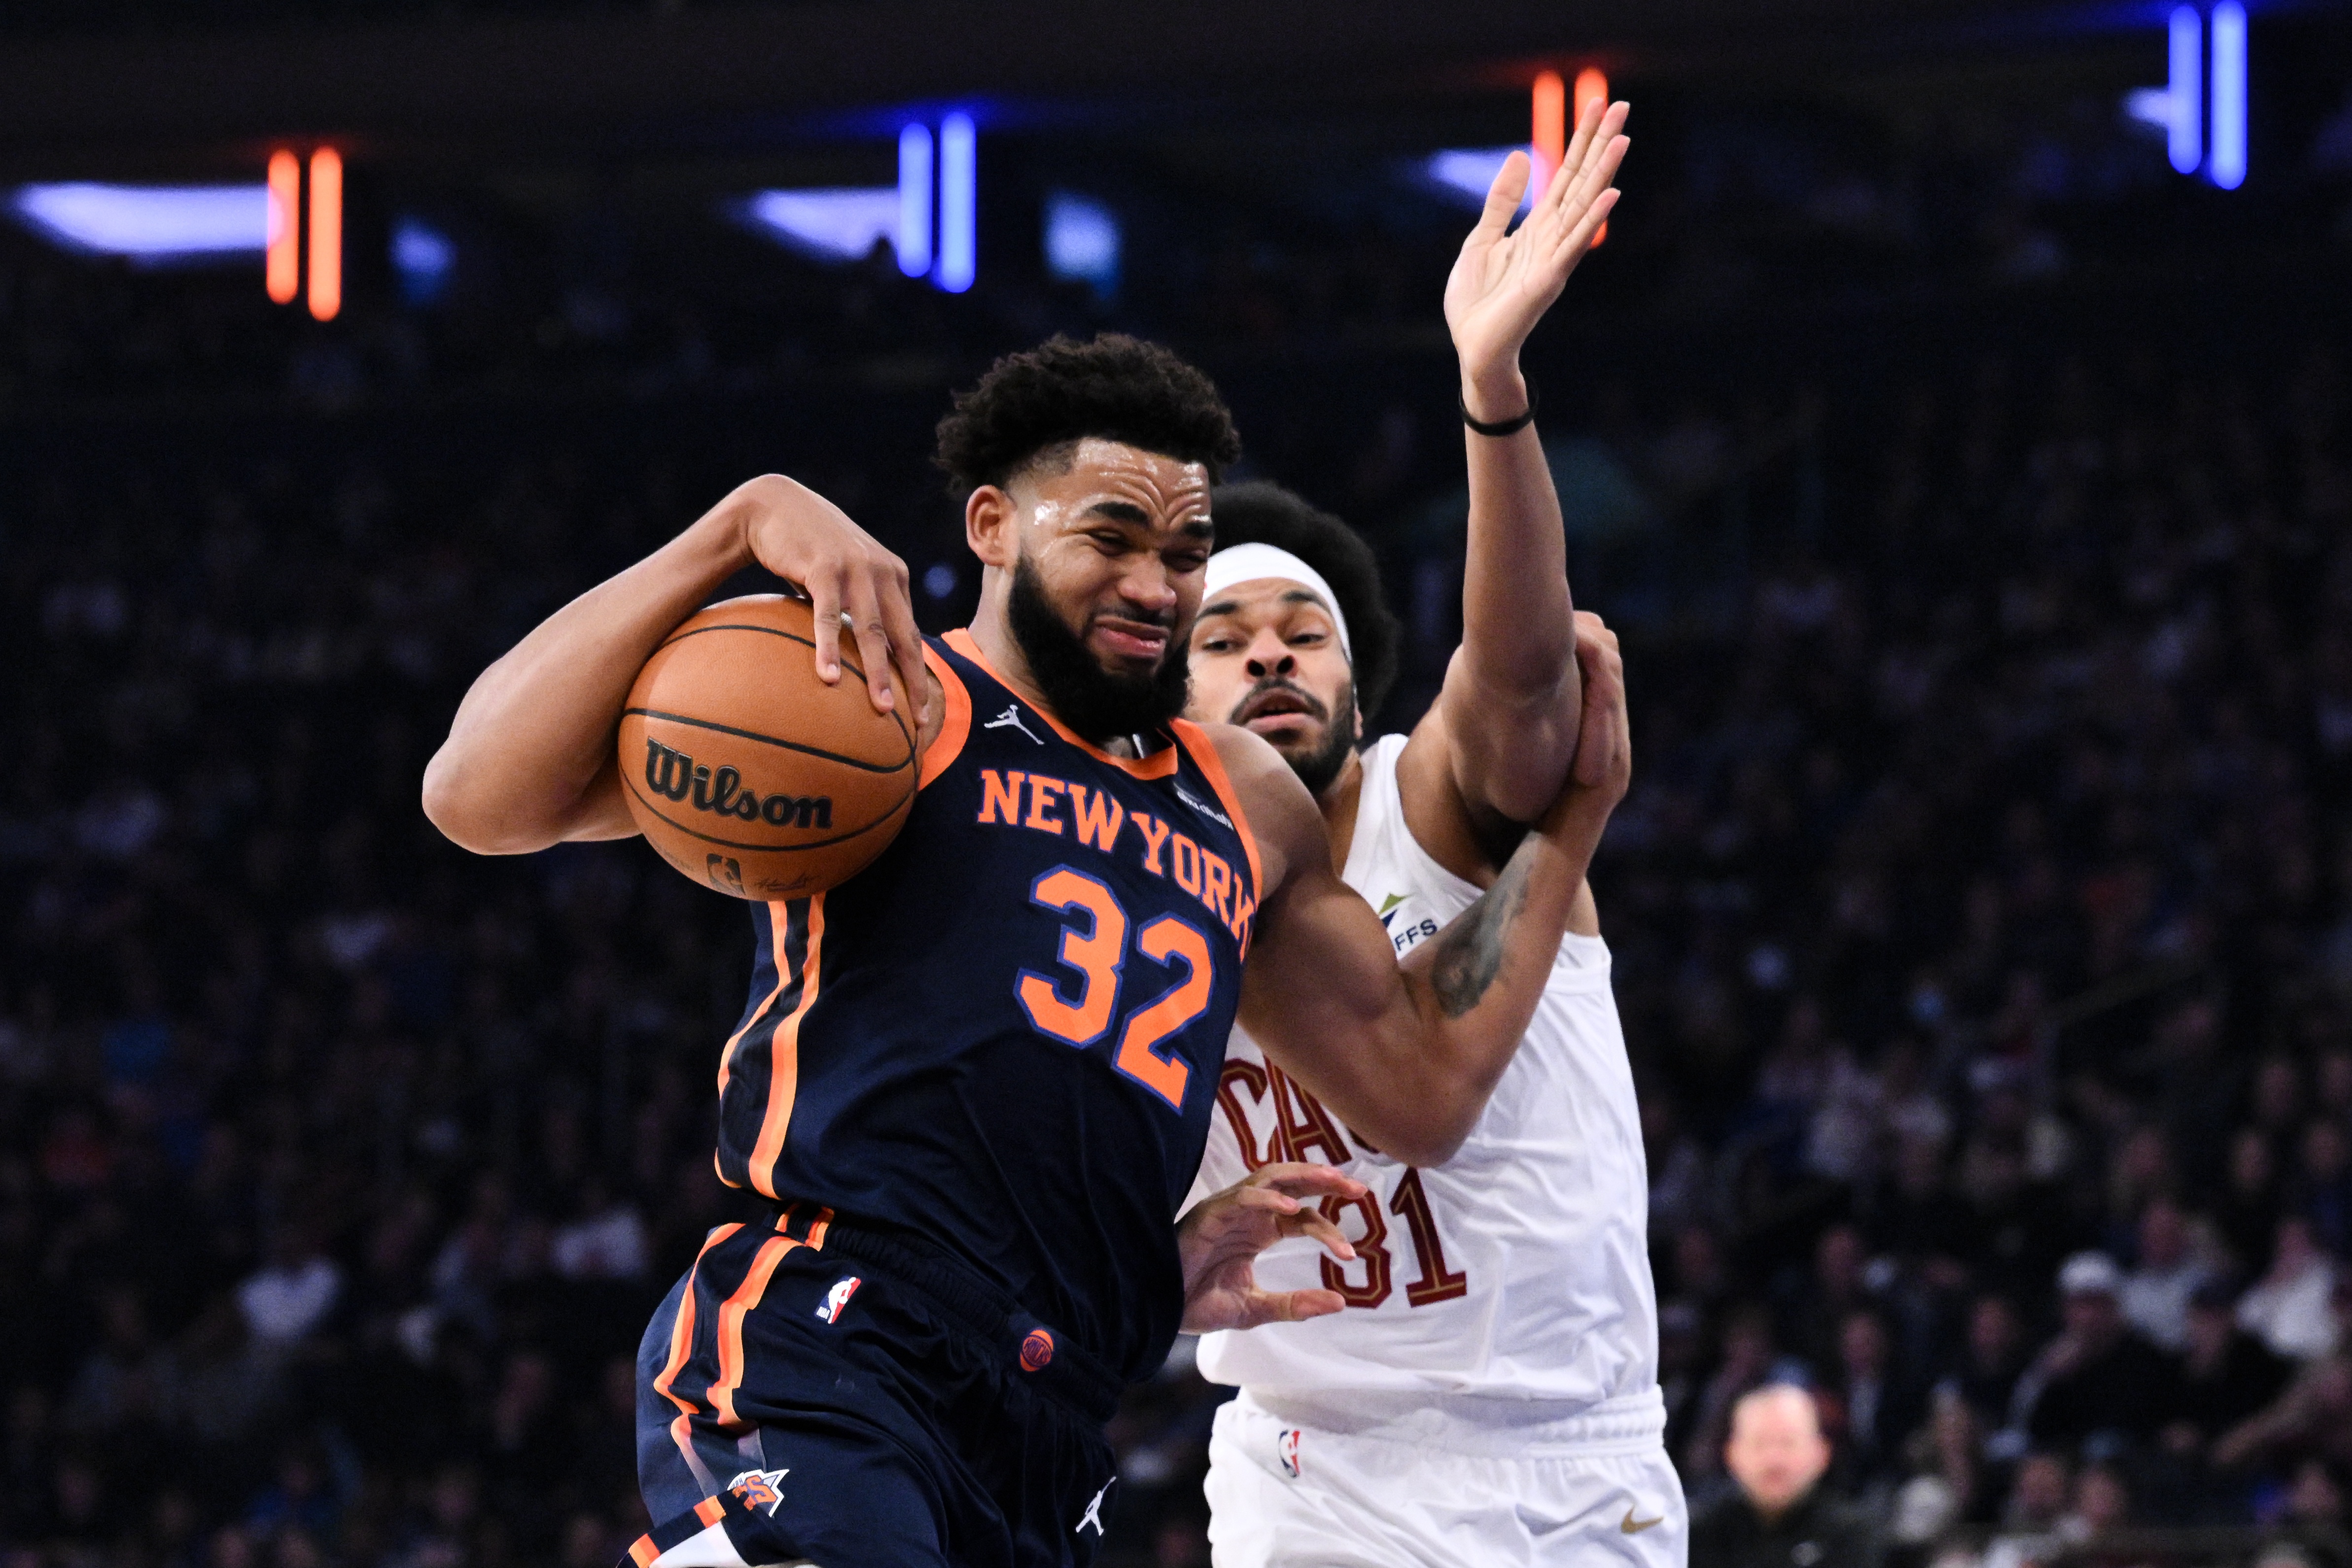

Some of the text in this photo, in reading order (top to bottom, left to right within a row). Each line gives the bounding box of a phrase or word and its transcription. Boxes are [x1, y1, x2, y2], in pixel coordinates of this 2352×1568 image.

[646, 737, 832, 829] Wilson
[978, 769, 1255, 964] NEW YORK
[1013, 864, 1216, 1116] 32
[1318, 1167, 1467, 1309] 31
[816, 1306, 830, 1320] NBA
